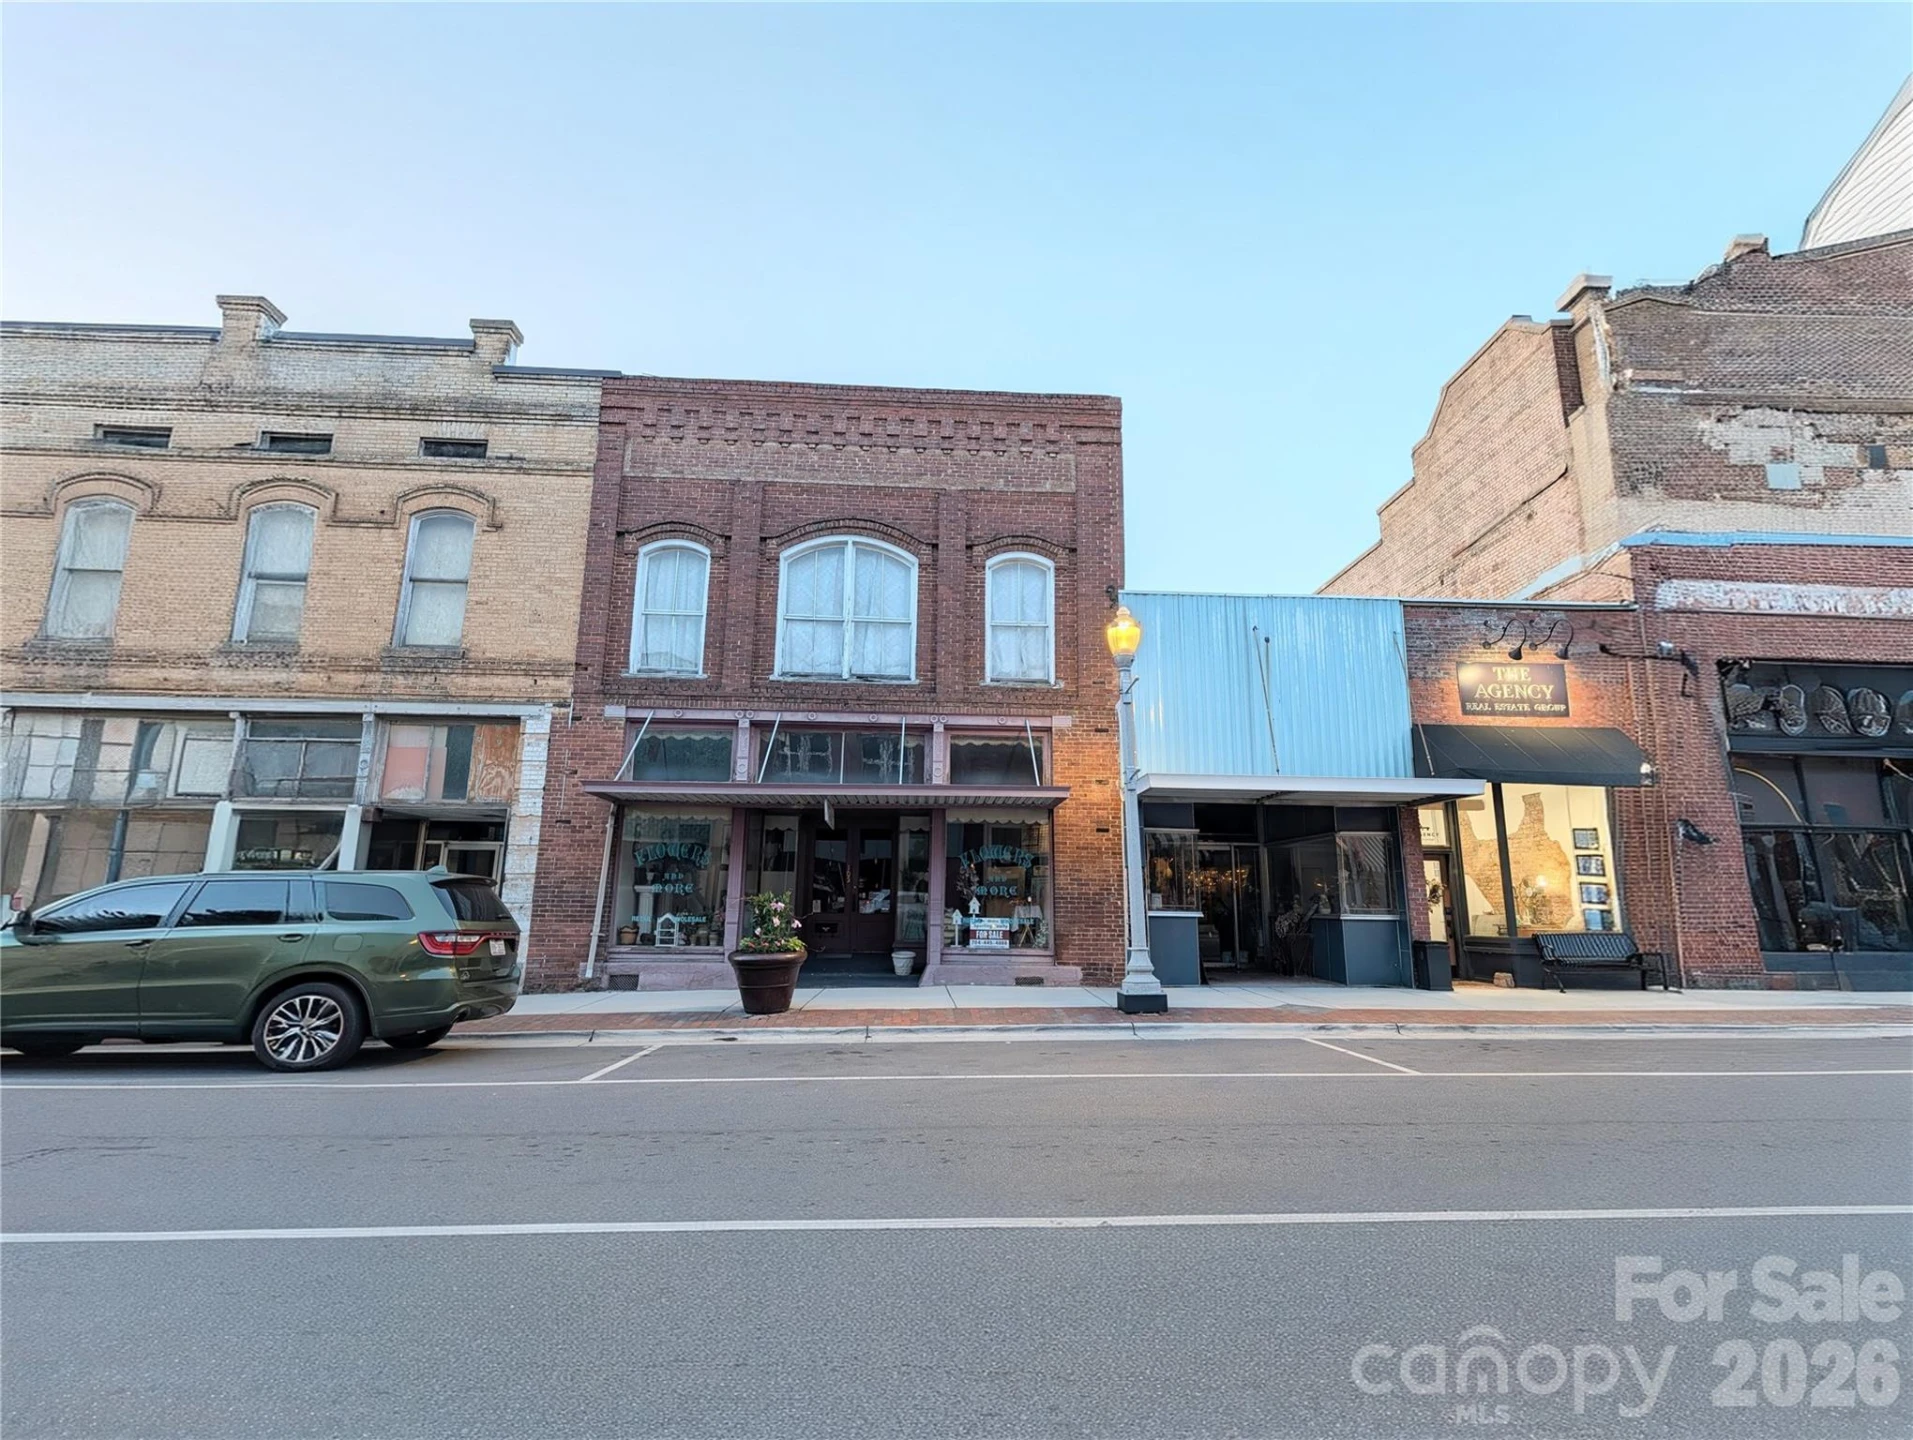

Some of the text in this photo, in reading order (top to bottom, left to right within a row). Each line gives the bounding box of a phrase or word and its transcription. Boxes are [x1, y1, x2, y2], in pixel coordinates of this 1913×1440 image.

[1492, 666, 1531, 682] THE
[1474, 683, 1554, 700] AGENCY
[1465, 702, 1567, 713] REAL ESTATE GROUP
[634, 842, 712, 869] FLOWERS
[959, 844, 1035, 869] FLOWERS
[651, 883, 695, 896] MORE
[975, 885, 1018, 898] MORE
[976, 930, 1004, 939] FOR SALE
